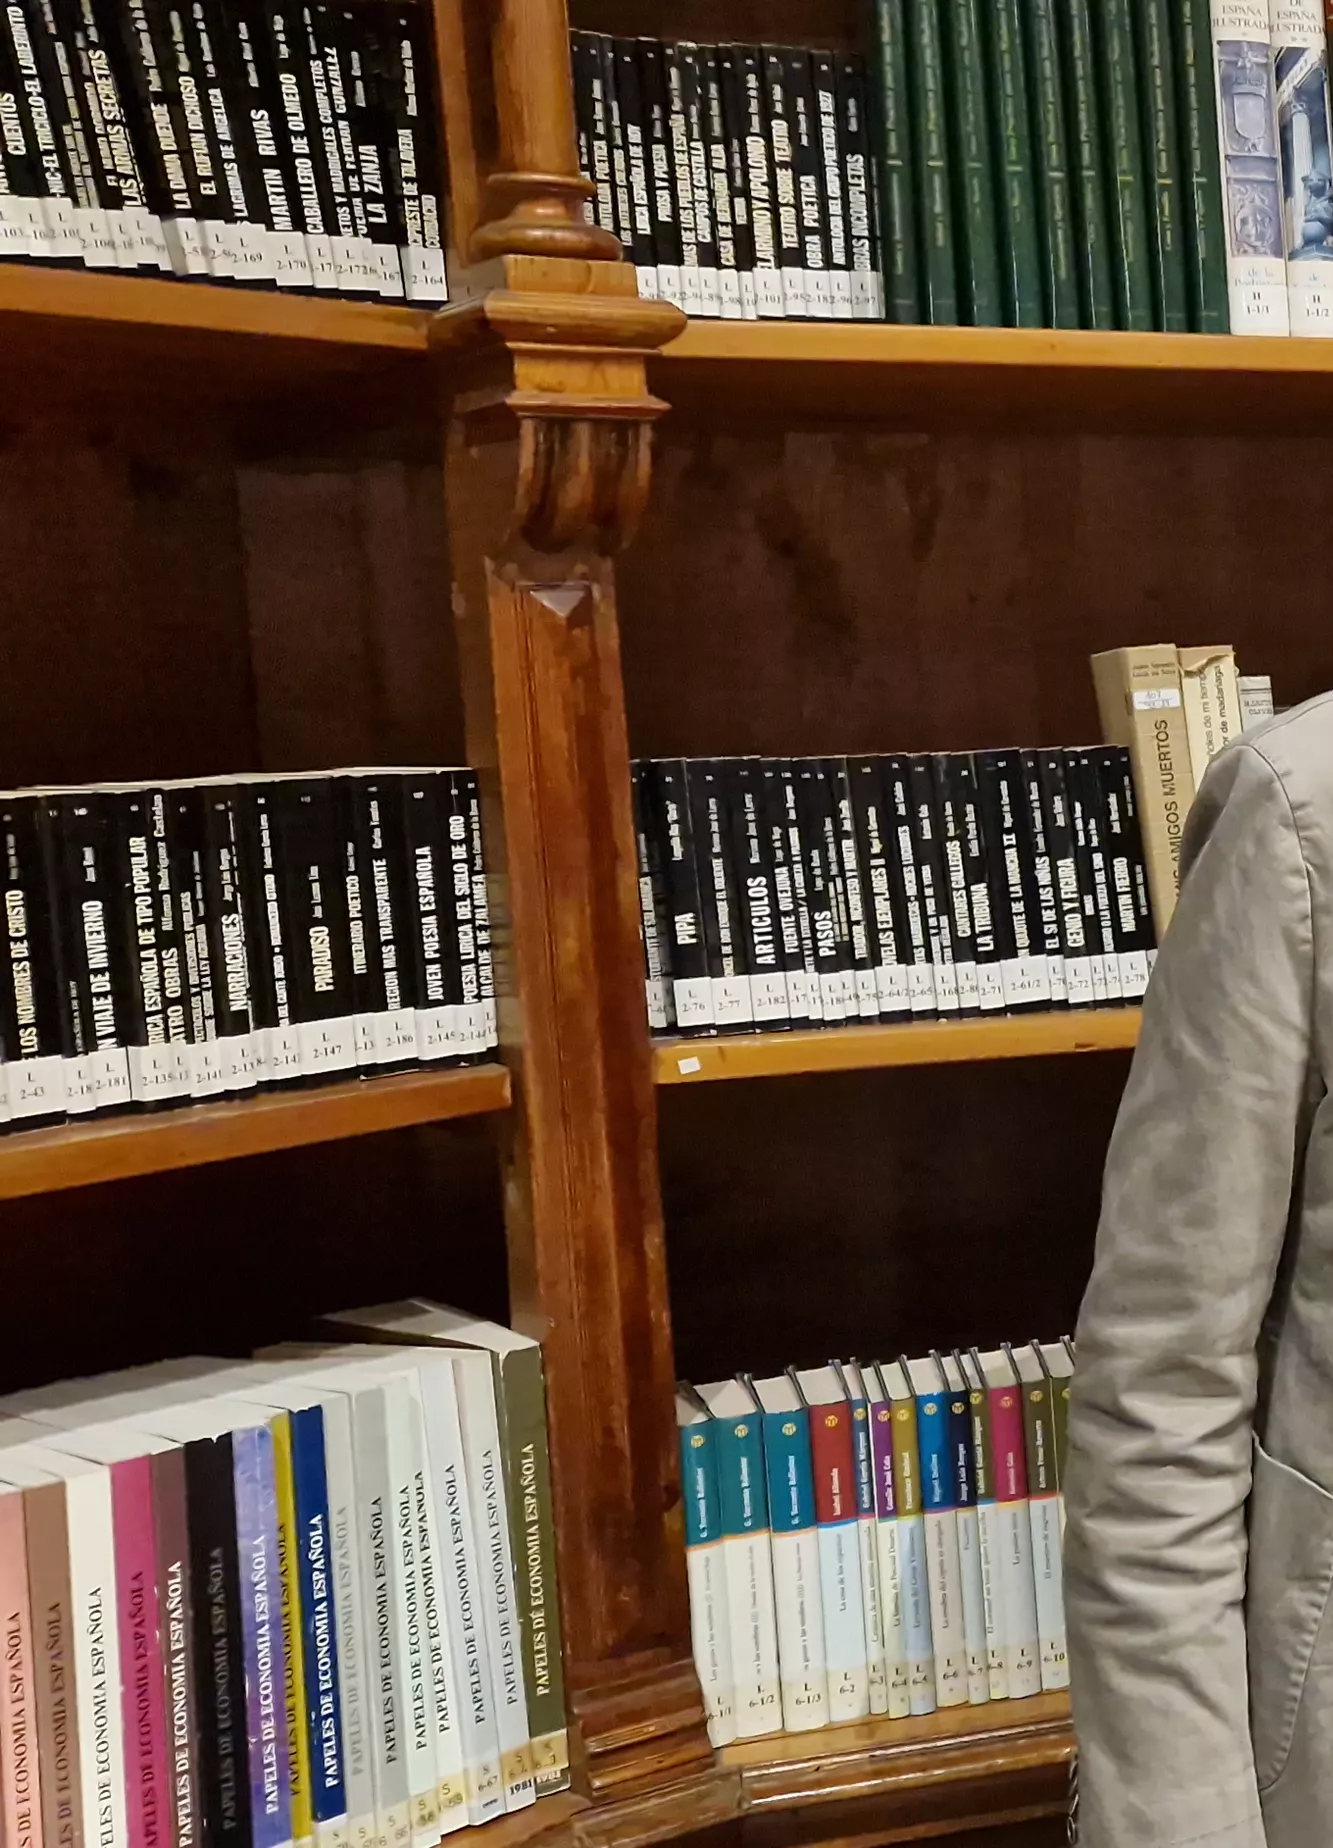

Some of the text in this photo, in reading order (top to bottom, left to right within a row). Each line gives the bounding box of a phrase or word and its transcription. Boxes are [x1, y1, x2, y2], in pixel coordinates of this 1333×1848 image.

[6, 6, 38, 75] LABERINTO
[0, 92, 27, 156] CUENTOS
[87, 49, 143, 206] LAS ARMAS SECRETAS
[150, 101, 192, 209] LA DAMA DUENDE
[279, 73, 324, 235] CABALLERO DE OLMEDO
[689, 141, 708, 187] CASTILLA
[250, 109, 293, 232] MARTIN RIVAS
[357, 145, 388, 224] LA ZANJA
[693, 187, 709, 202] DE
[770, 119, 799, 249] TEATRO SOBRE TEATRO
[846, 153, 869, 237] INCOMPLETAS
[799, 175, 824, 269] OBRA POETICA
[1202, 701, 1212, 729] de mi
[1214, 664, 1229, 734] de madariaga
[1154, 719, 1183, 864] AMIGOS MUERTOS
[129, 836, 162, 1012] ESPAÑOLA DE TIPO POPULAR
[415, 846, 444, 1000] JOVEN POESIA ESPAÑOLA
[448, 815, 479, 1005] POESIA LIRICA DEL SIGLO DE ORO
[674, 912, 697, 945] PIPA
[746, 876, 776, 964] ARTICULOS
[774, 865, 800, 954] FUENTE OVEJUNA
[945, 840, 972, 938] CANTARES GALLEGOS
[970, 882, 994, 952] LA TRIBUNA
[1034, 855, 1060, 949] EL SI DE LAS NIÑAS
[1056, 857, 1085, 948] GENIO Y FIGURA
[1112, 857, 1136, 933] MARTIN FIERRO
[5, 889, 39, 1054] LOS NOMBRES DE CRISTO
[81, 900, 116, 1036] VIAJE DE INVIERNO
[161, 947, 182, 998] OBRAS
[221, 912, 250, 1012] NARRACIONES
[309, 925, 334, 992] PARADISO
[372, 858, 401, 1010] REGION MAS TRANSPARENTE
[813, 910, 838, 957] PASOS
[313, 1045, 342, 1059] 2-147
[520, 1443, 538, 1522] ESPAÑOLA
[445, 1464, 485, 1725] PAPELES DE ECONOMIA ESPAÑOLA
[526, 1524, 544, 1607] ECONOMIA
[308, 1514, 339, 1788] PAPELES DE ECONOMIA ESPAÑOLA
[399, 1485, 427, 1750] PAPELES DE ECONOMIA ESPAÑOLA
[1043, 1652, 1066, 1663] 6-10
[166, 1561, 193, 1848] PAPELES DE ECONOMIA ESPAÑOLA
[250, 1534, 279, 1815] PAPELES DE ECONOMIA ESPAÑOLA
[533, 1631, 550, 1697] PAPELES
[748, 1694, 775, 1709] 6-1/2
[795, 1693, 822, 1706] 6-1/3
[839, 1683, 855, 1695] 6-2
[509, 1778, 532, 1795] 1981
